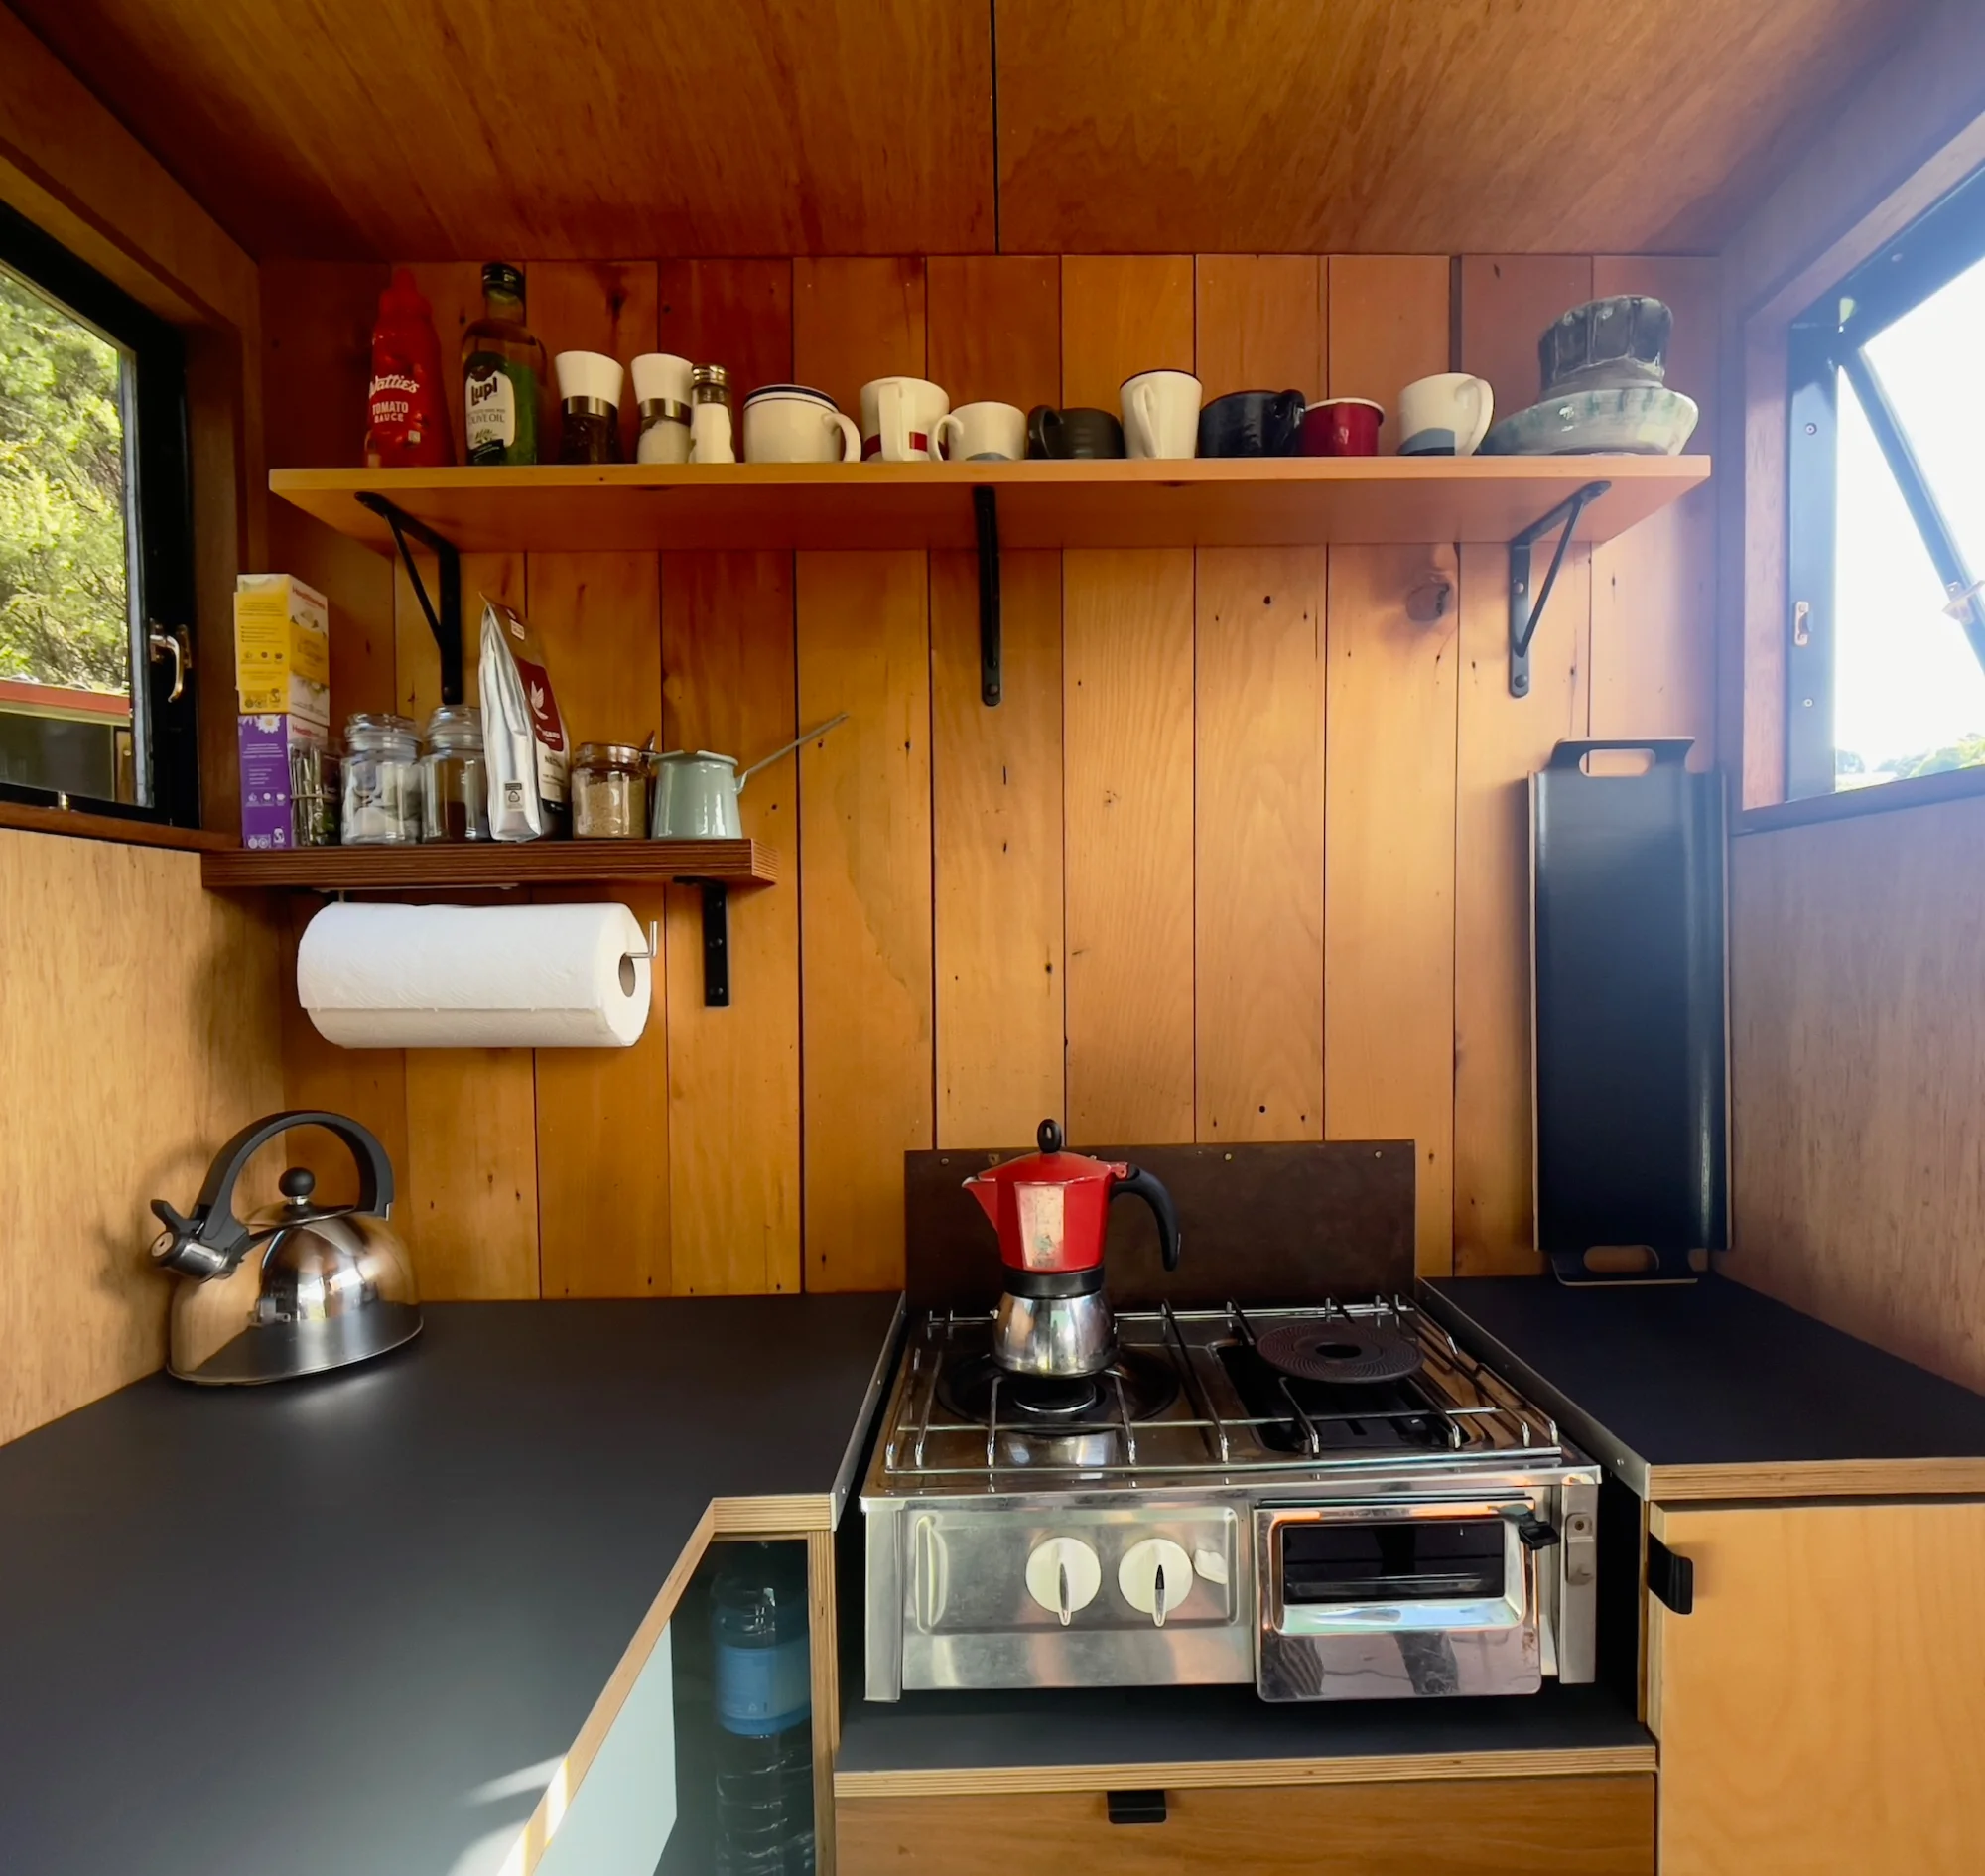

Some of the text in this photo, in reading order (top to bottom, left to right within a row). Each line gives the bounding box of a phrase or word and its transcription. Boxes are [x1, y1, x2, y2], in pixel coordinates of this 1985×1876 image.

[372, 400, 409, 415] TOMATO
[374, 412, 404, 423] SAUCE
[488, 413, 505, 424] OIL
